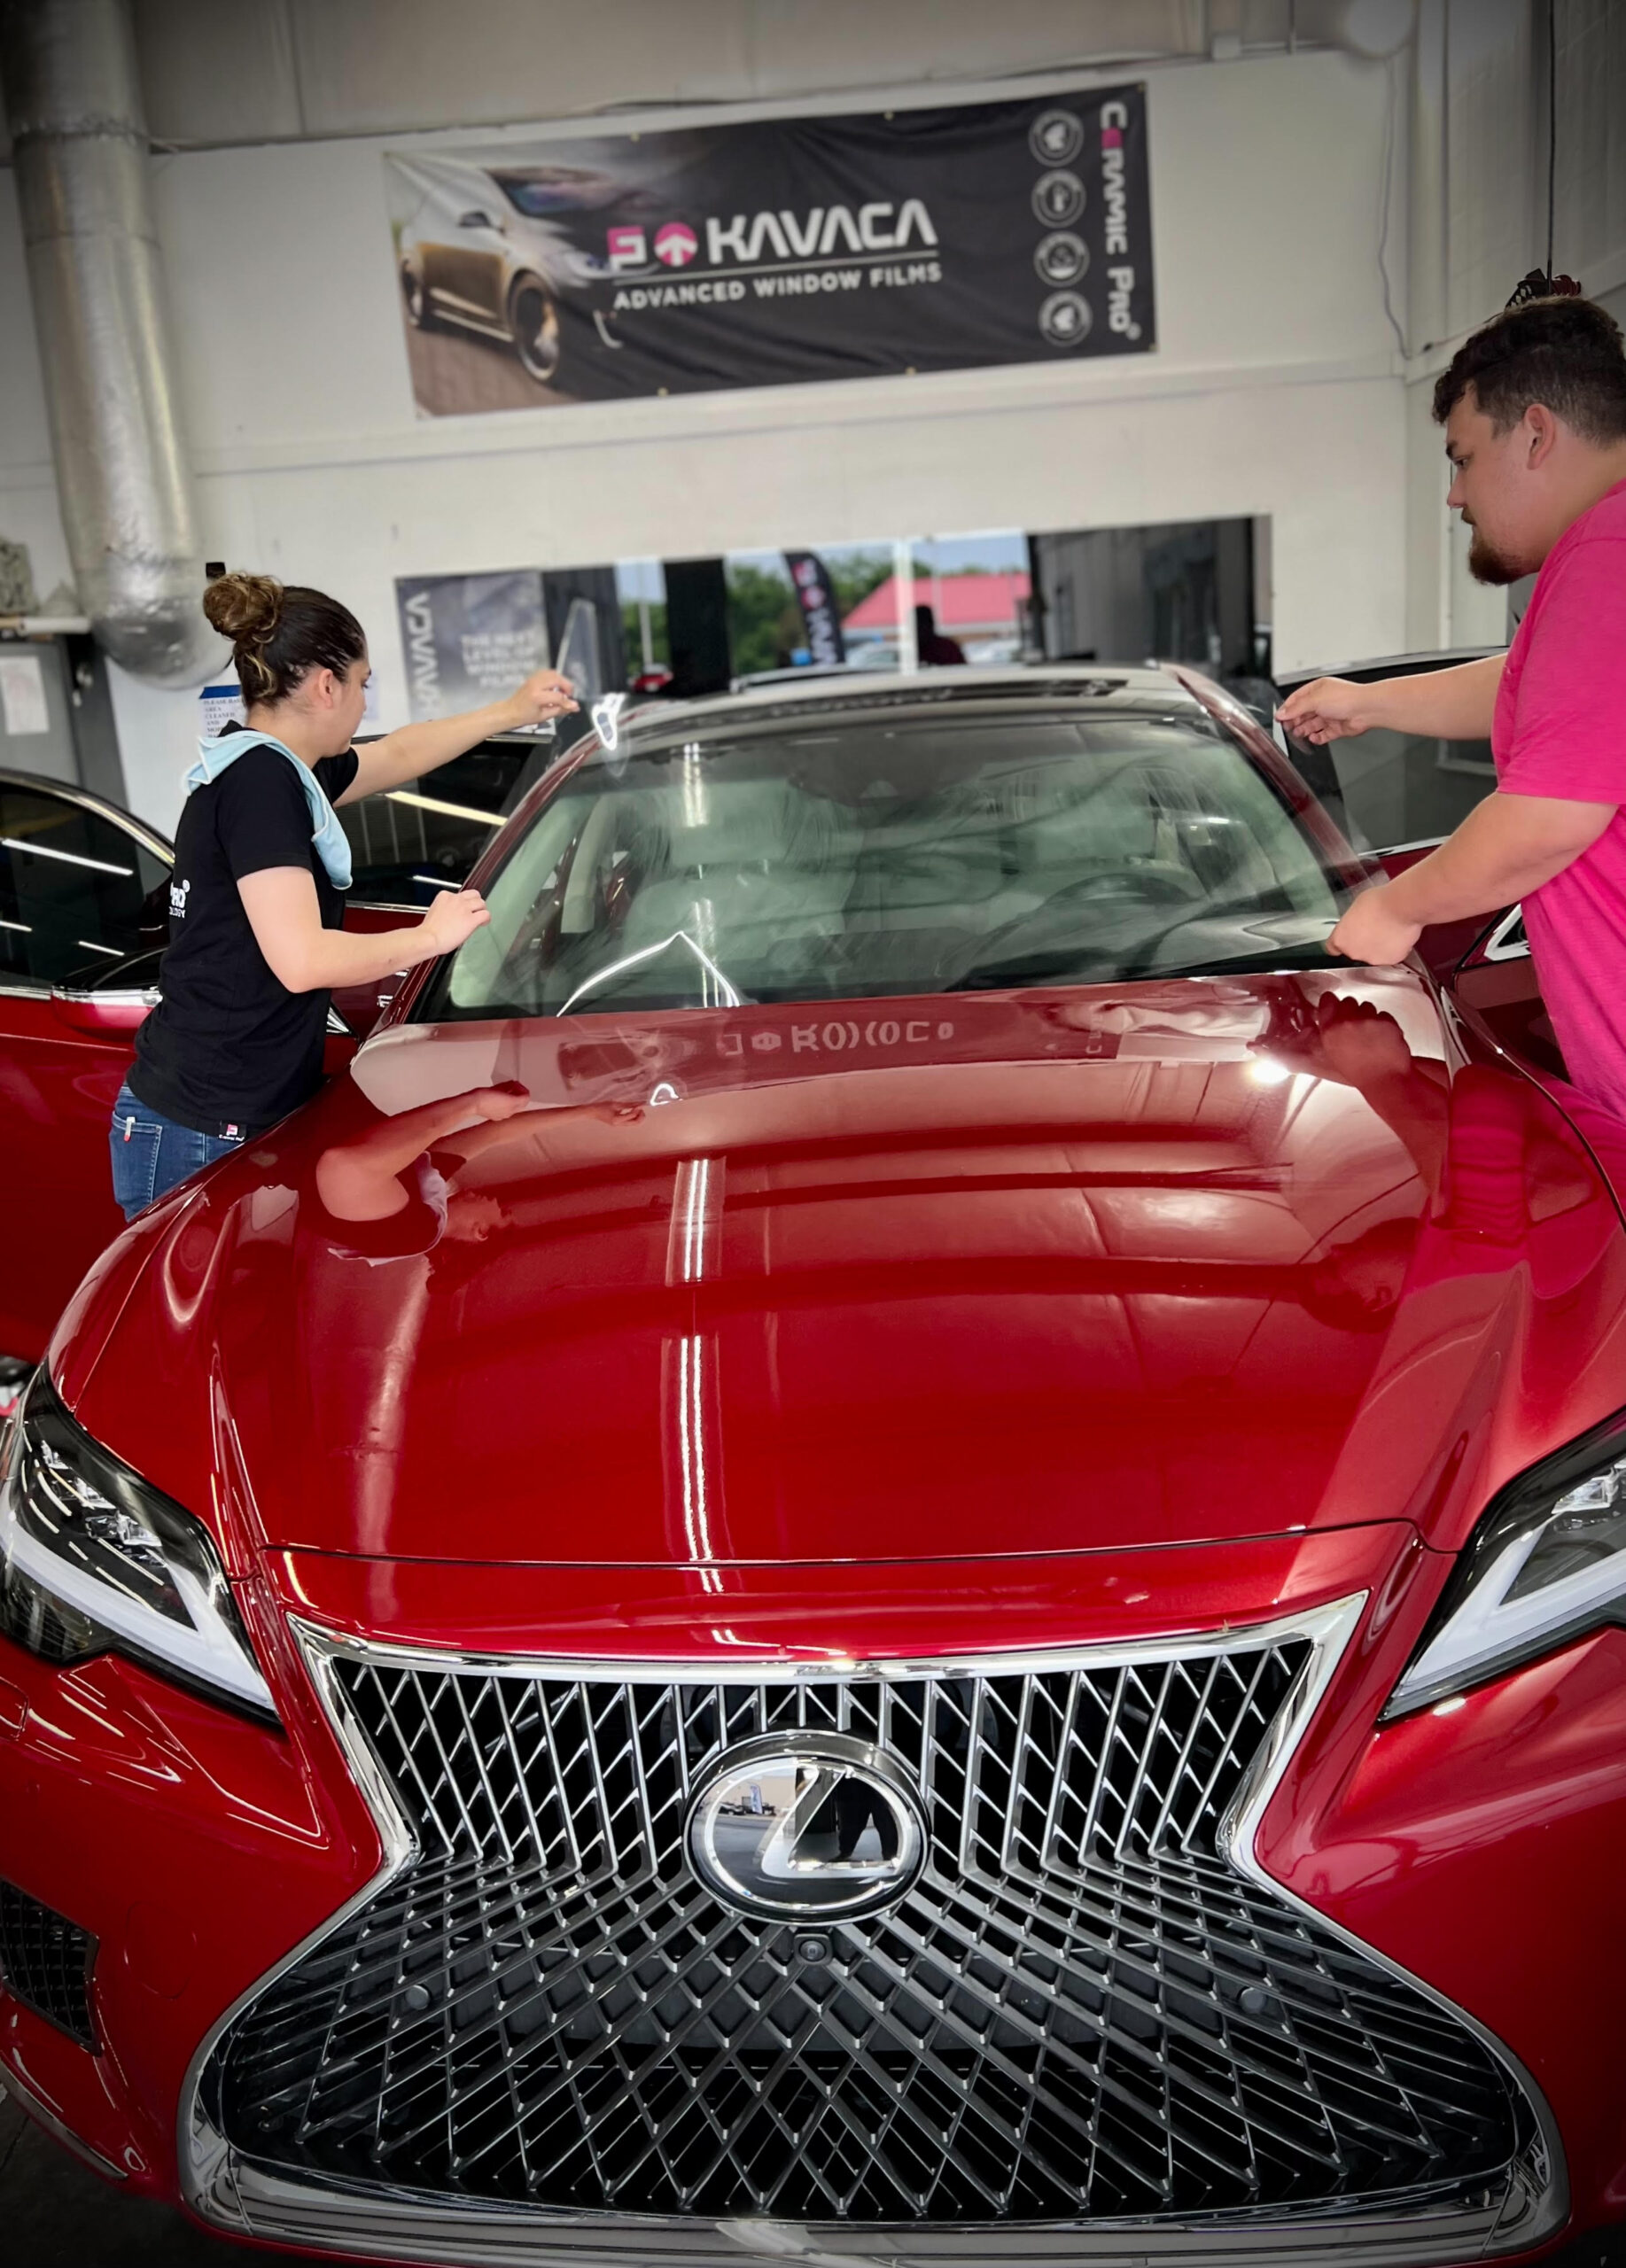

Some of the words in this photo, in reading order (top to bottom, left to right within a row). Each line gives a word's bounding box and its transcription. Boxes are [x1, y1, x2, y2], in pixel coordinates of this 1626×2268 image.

[706, 198, 938, 264] KAVACA
[613, 280, 745, 310] ADVANCED
[753, 269, 862, 298] WINDOW
[870, 261, 942, 288] FILMS
